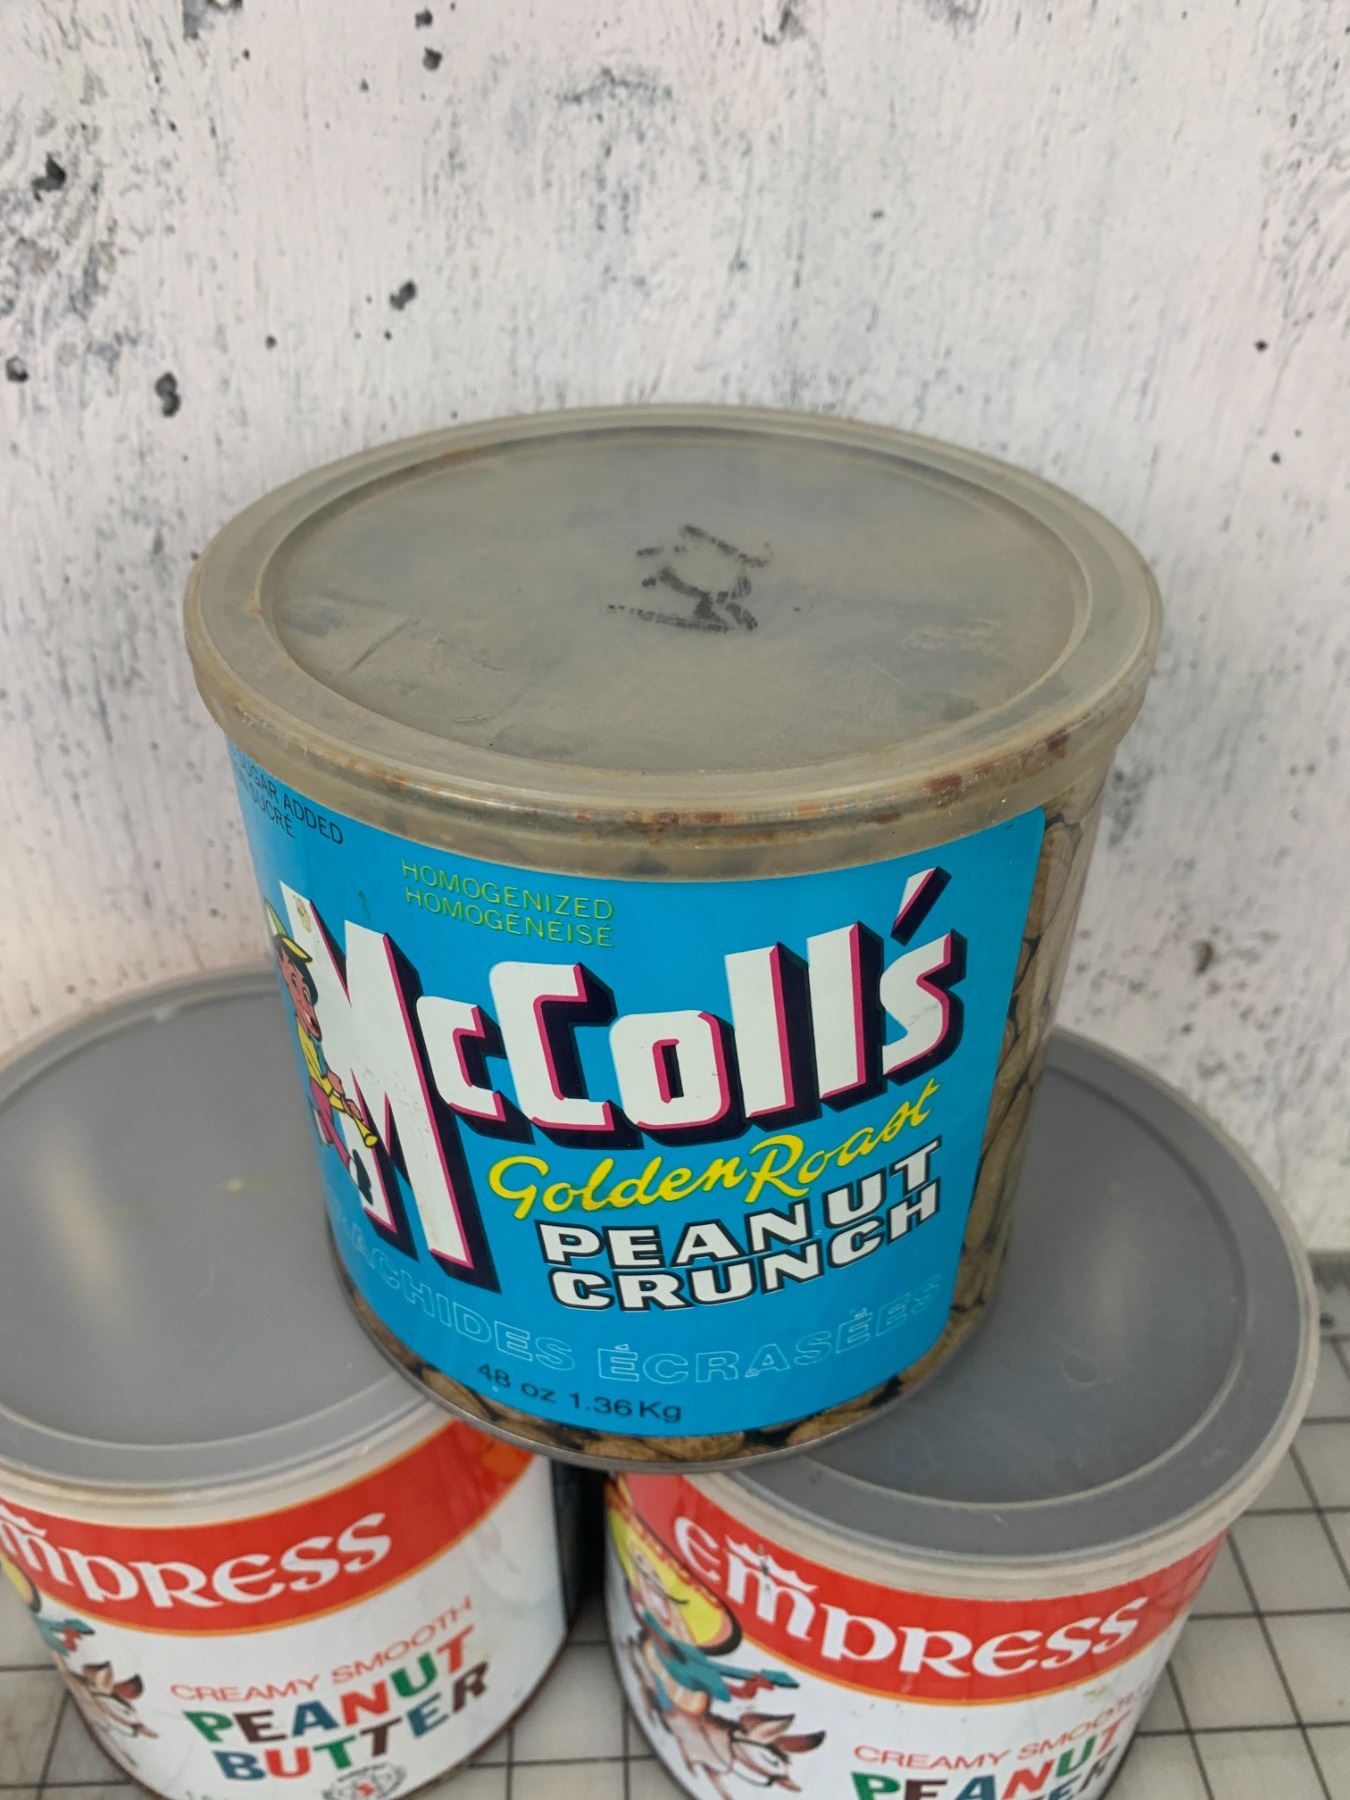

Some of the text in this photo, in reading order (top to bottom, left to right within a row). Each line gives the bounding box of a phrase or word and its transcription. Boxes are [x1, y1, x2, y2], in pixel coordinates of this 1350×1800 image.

[284, 793, 344, 844] ADDED
[401, 858, 614, 920] HOMOGENIZED
[279, 866, 967, 1293] McColl's
[488, 1077, 941, 1221] Golden Roast
[534, 1135, 943, 1270] PEANUT
[548, 1178, 939, 1312] CRUNCH
[597, 1273, 943, 1384] ÉCRASÉES
[477, 1363, 682, 1423] 48 oz 1.36 Kg
[0, 1512, 392, 1609] MPRESS
[170, 1595, 472, 1702] CREAMY SMOOTH
[182, 1623, 475, 1743] PEANUT
[213, 1661, 488, 1781] BUTTER
[852, 1745, 1012, 1770] CREAMY
